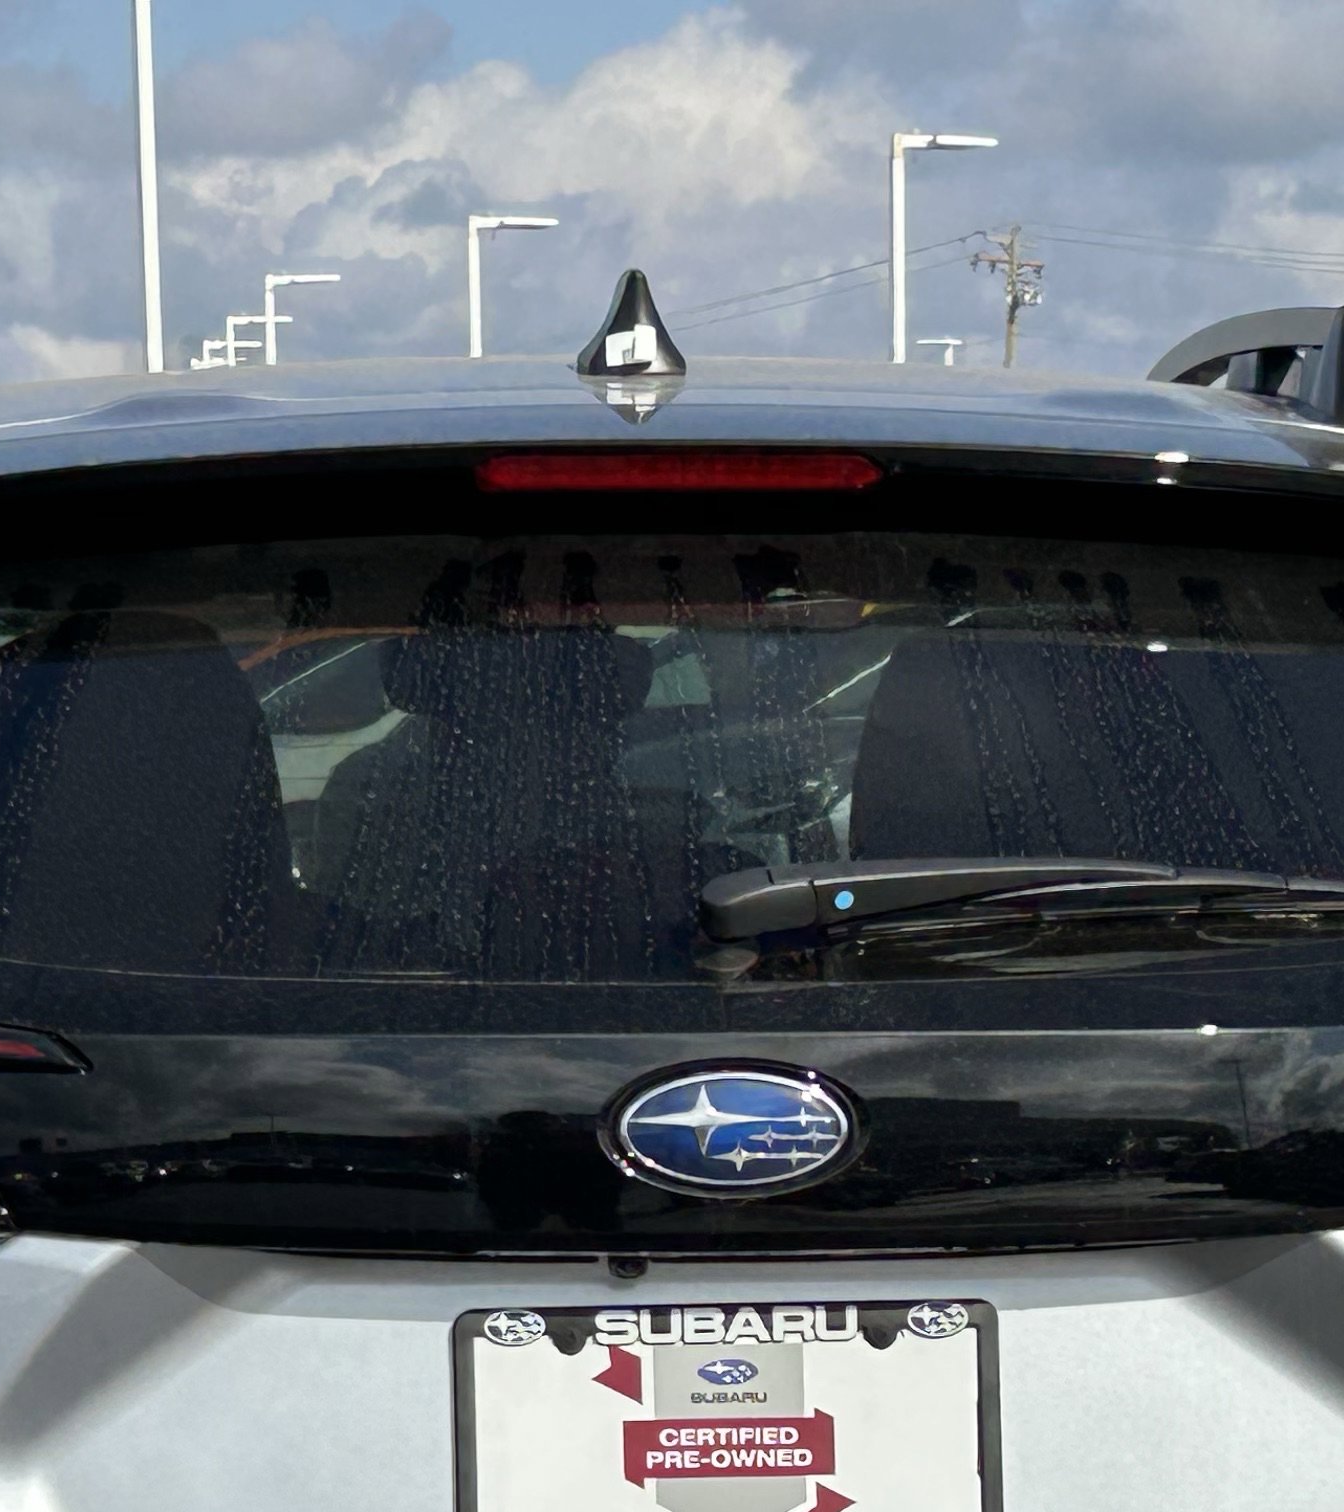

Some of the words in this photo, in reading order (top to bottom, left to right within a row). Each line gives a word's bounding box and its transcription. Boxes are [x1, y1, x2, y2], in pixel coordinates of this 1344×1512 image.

[593, 1304, 859, 1346] SUBARU
[690, 1391, 768, 1404] SUBARU
[658, 1426, 800, 1448] CERTIFIED
[645, 1448, 814, 1470] PRE-OWNED
